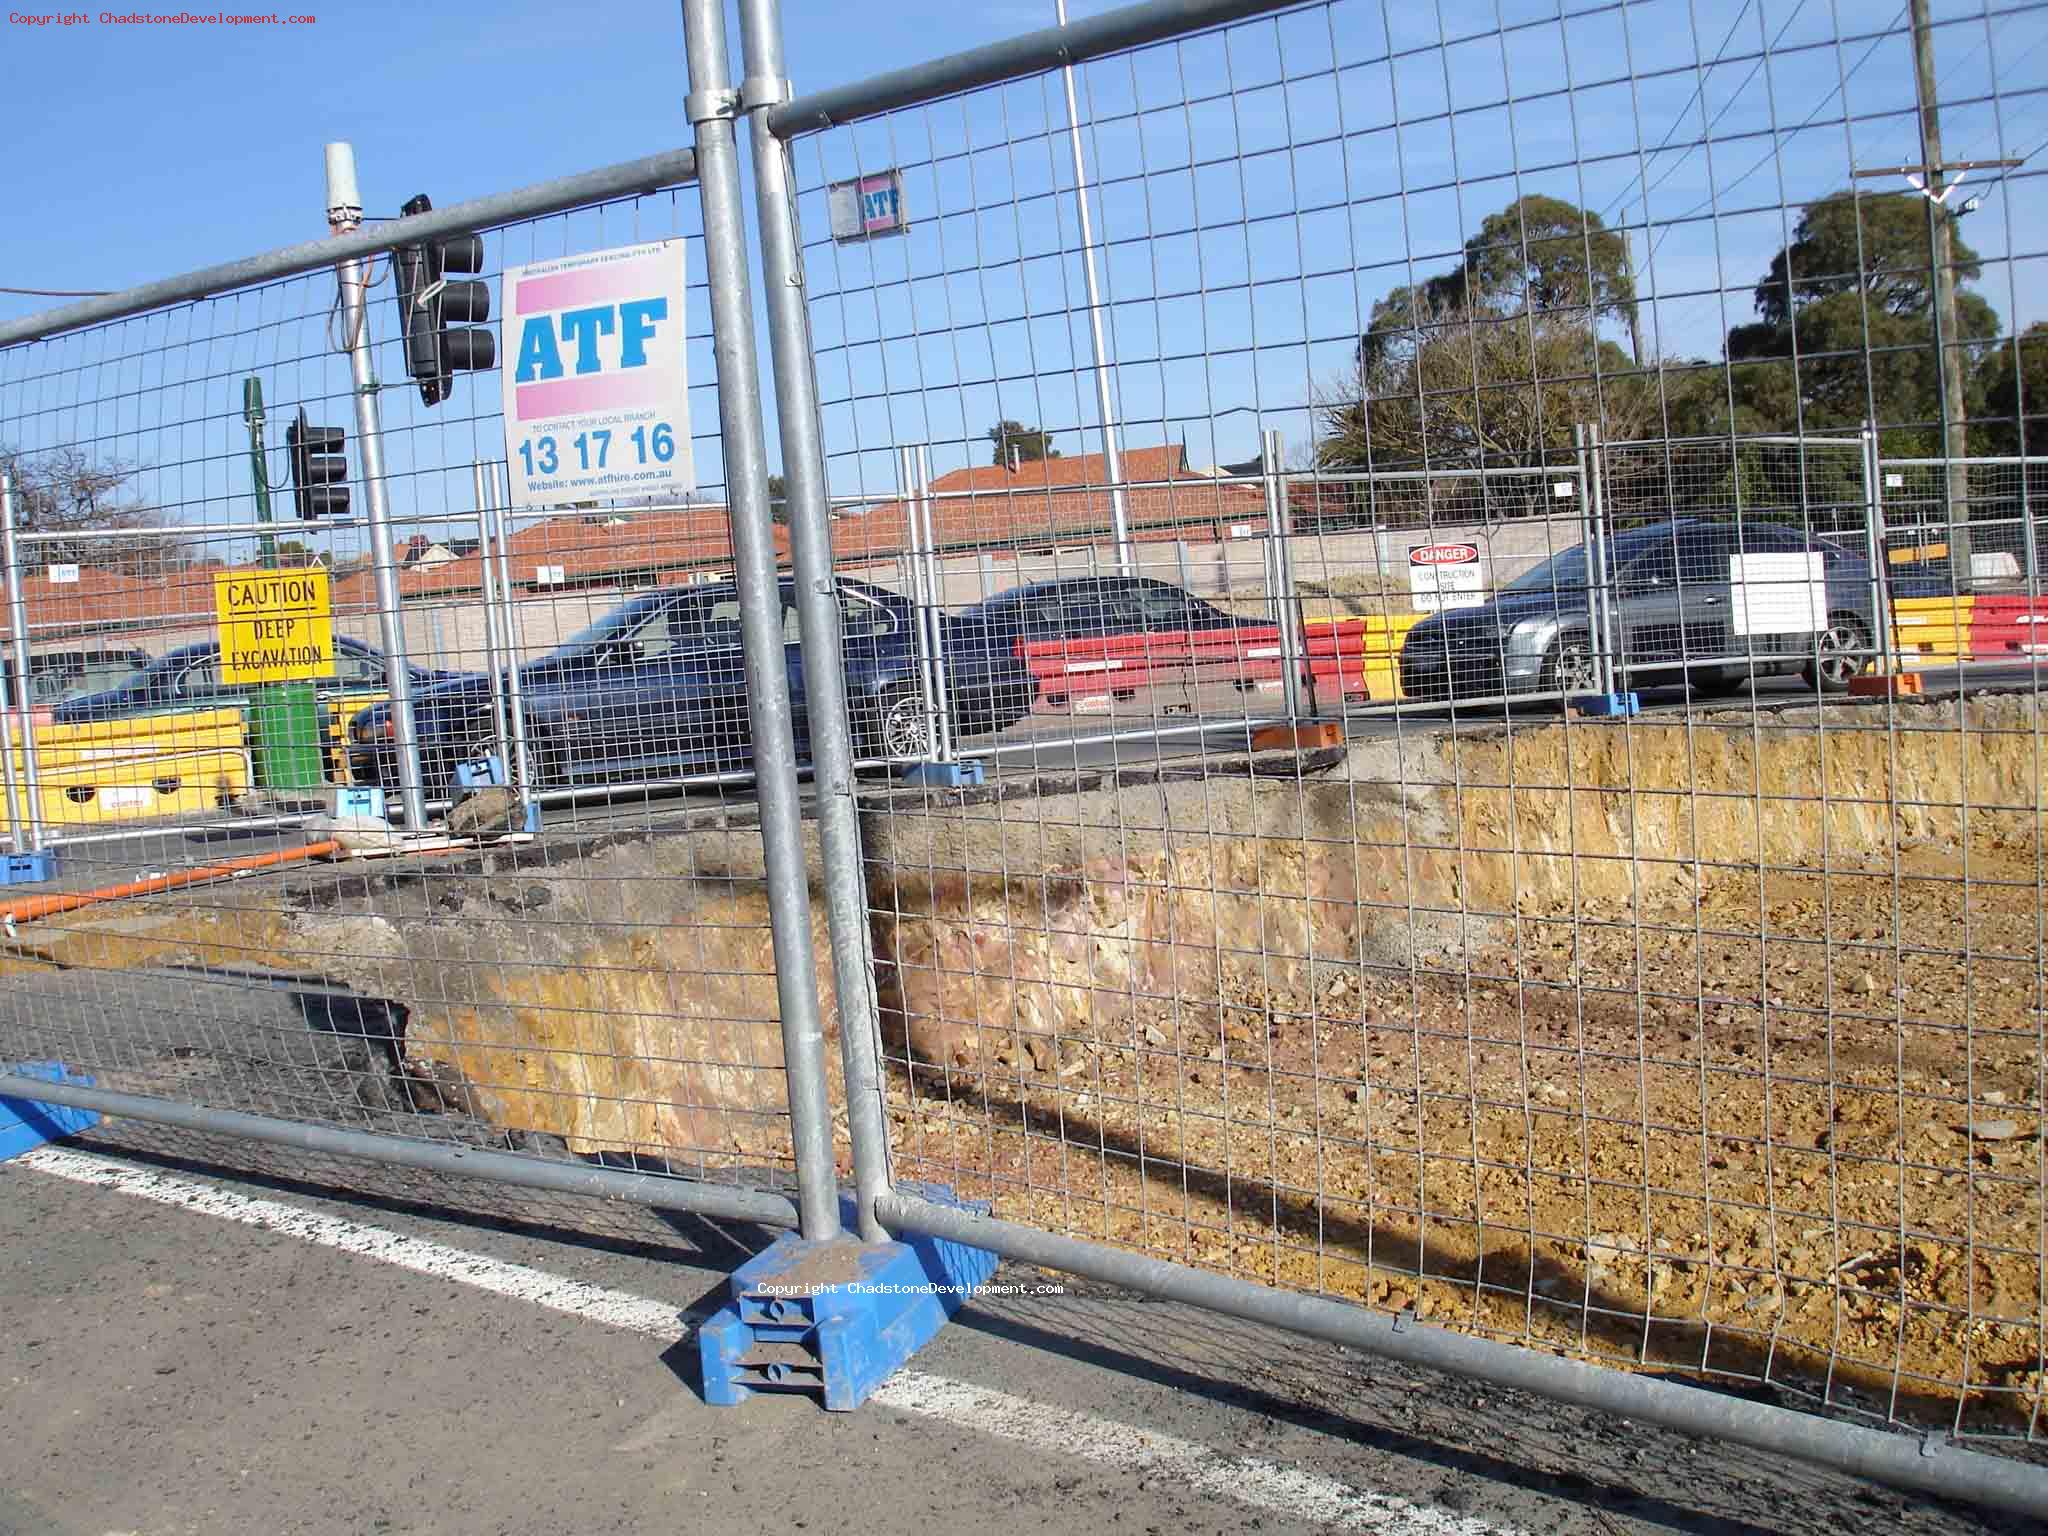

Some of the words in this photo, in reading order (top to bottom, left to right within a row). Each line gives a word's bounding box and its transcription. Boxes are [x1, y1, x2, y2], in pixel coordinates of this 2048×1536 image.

[515, 297, 668, 384] ATF
[543, 419, 576, 433] CONTACT
[599, 413, 624, 426] LOCAL
[519, 436, 559, 477] 13
[573, 429, 613, 470] 17
[630, 422, 676, 465] 16
[528, 478, 569, 493] Website:
[570, 469, 673, 488] www.atfhire.com.au
[1420, 549, 1468, 561] DANGER
[1418, 570, 1475, 581] CONTRUCTION
[228, 580, 316, 606] CAUTION
[254, 618, 295, 641] DEEP
[231, 645, 322, 672] EXCAVATION
